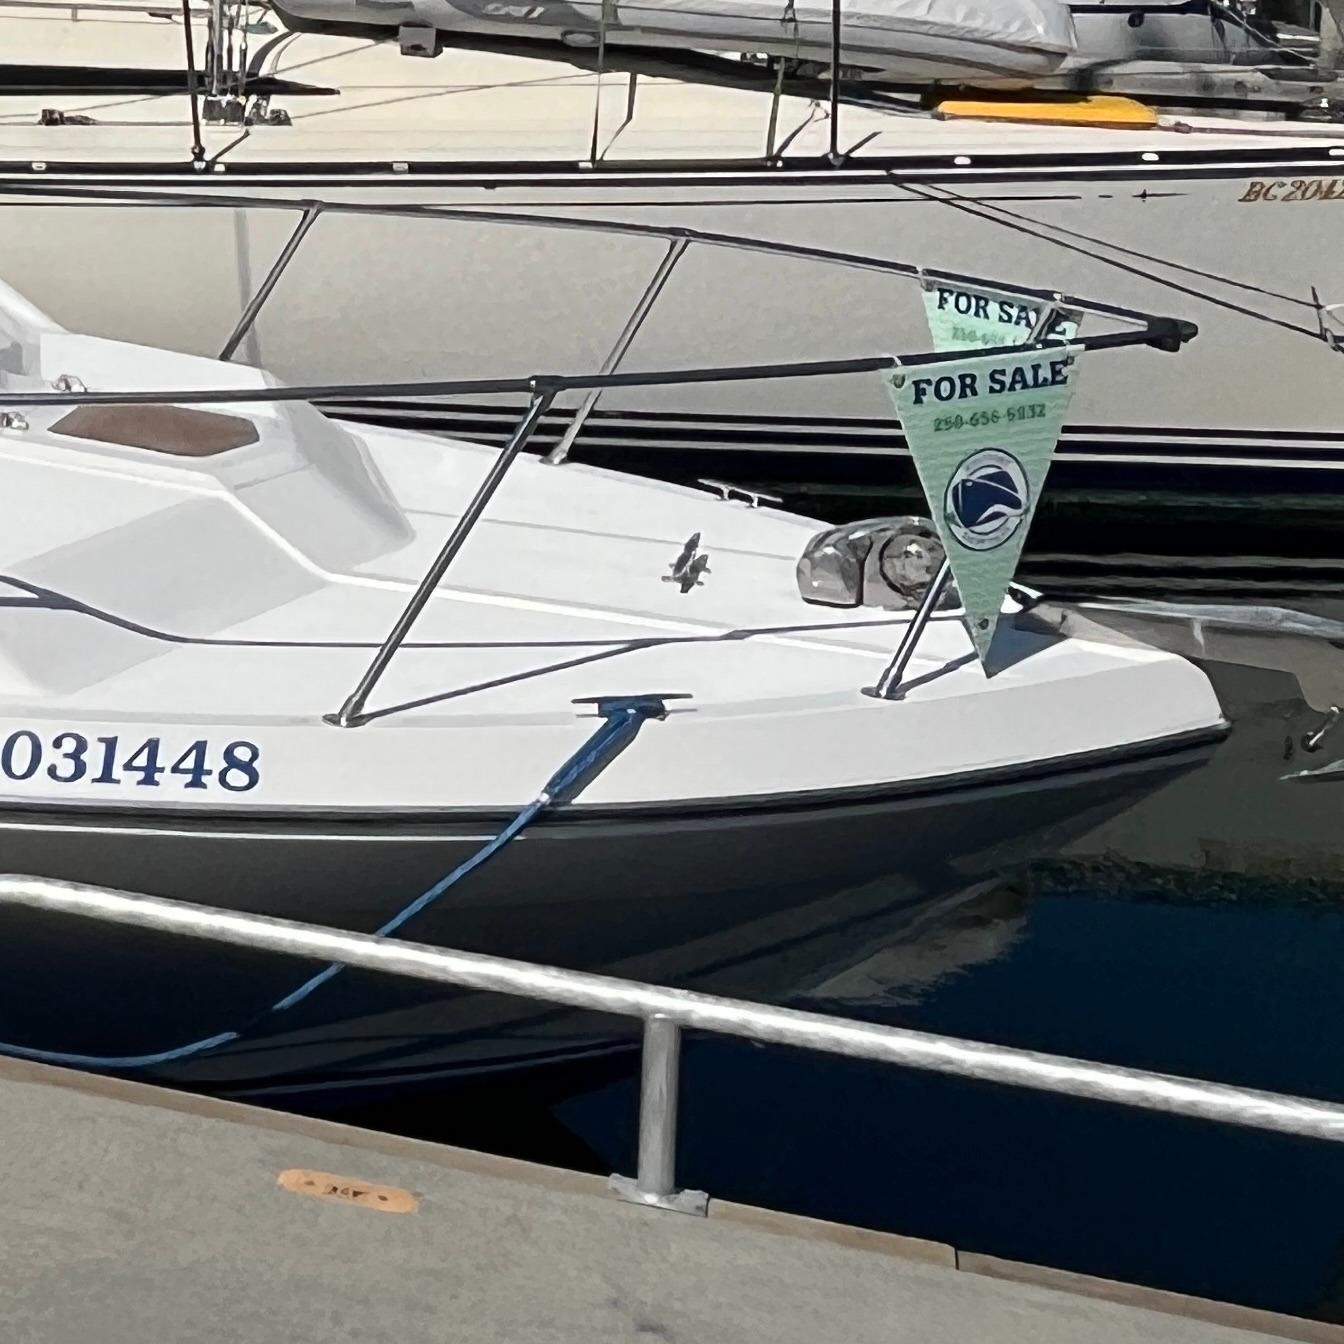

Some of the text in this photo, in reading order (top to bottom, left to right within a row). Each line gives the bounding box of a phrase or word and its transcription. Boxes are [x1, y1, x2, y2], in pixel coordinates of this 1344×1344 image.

[936, 287, 990, 320] FOR
[912, 359, 1069, 406] FOR SALE
